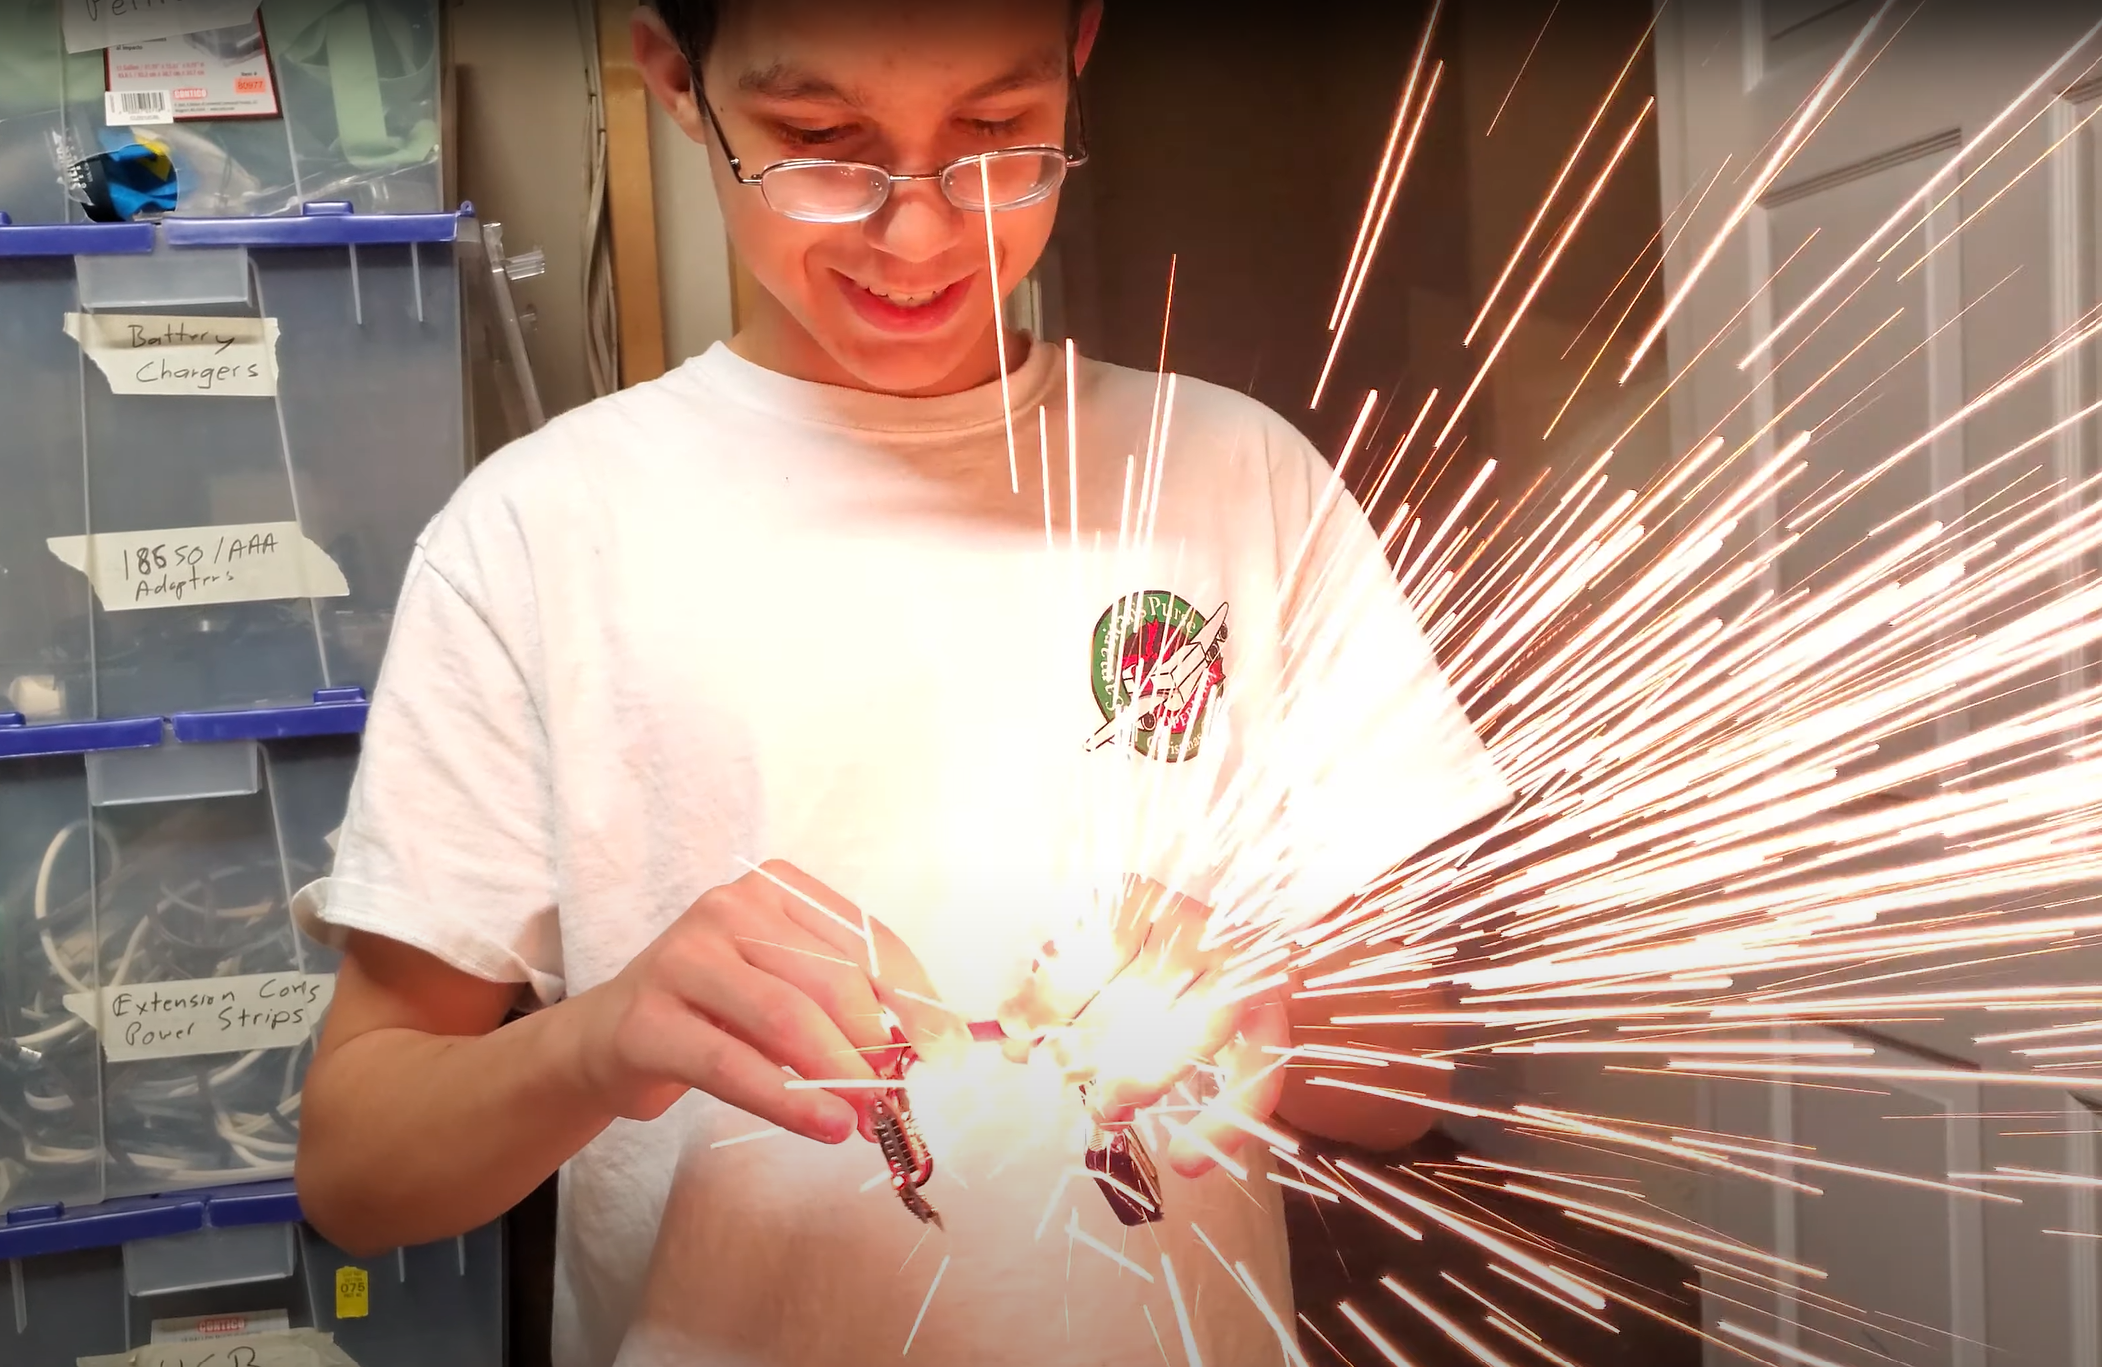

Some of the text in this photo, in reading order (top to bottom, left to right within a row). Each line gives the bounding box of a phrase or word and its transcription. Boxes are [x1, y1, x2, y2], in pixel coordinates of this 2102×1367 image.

[173, 88, 207, 99] CONTICO
[128, 323, 235, 355] Battery
[136, 358, 259, 389] Chargers
[112, 991, 235, 1017] Extension
[125, 1006, 304, 1046] Power Strips
[340, 1281, 366, 1293] 075
[199, 1318, 246, 1332] CONTICO
